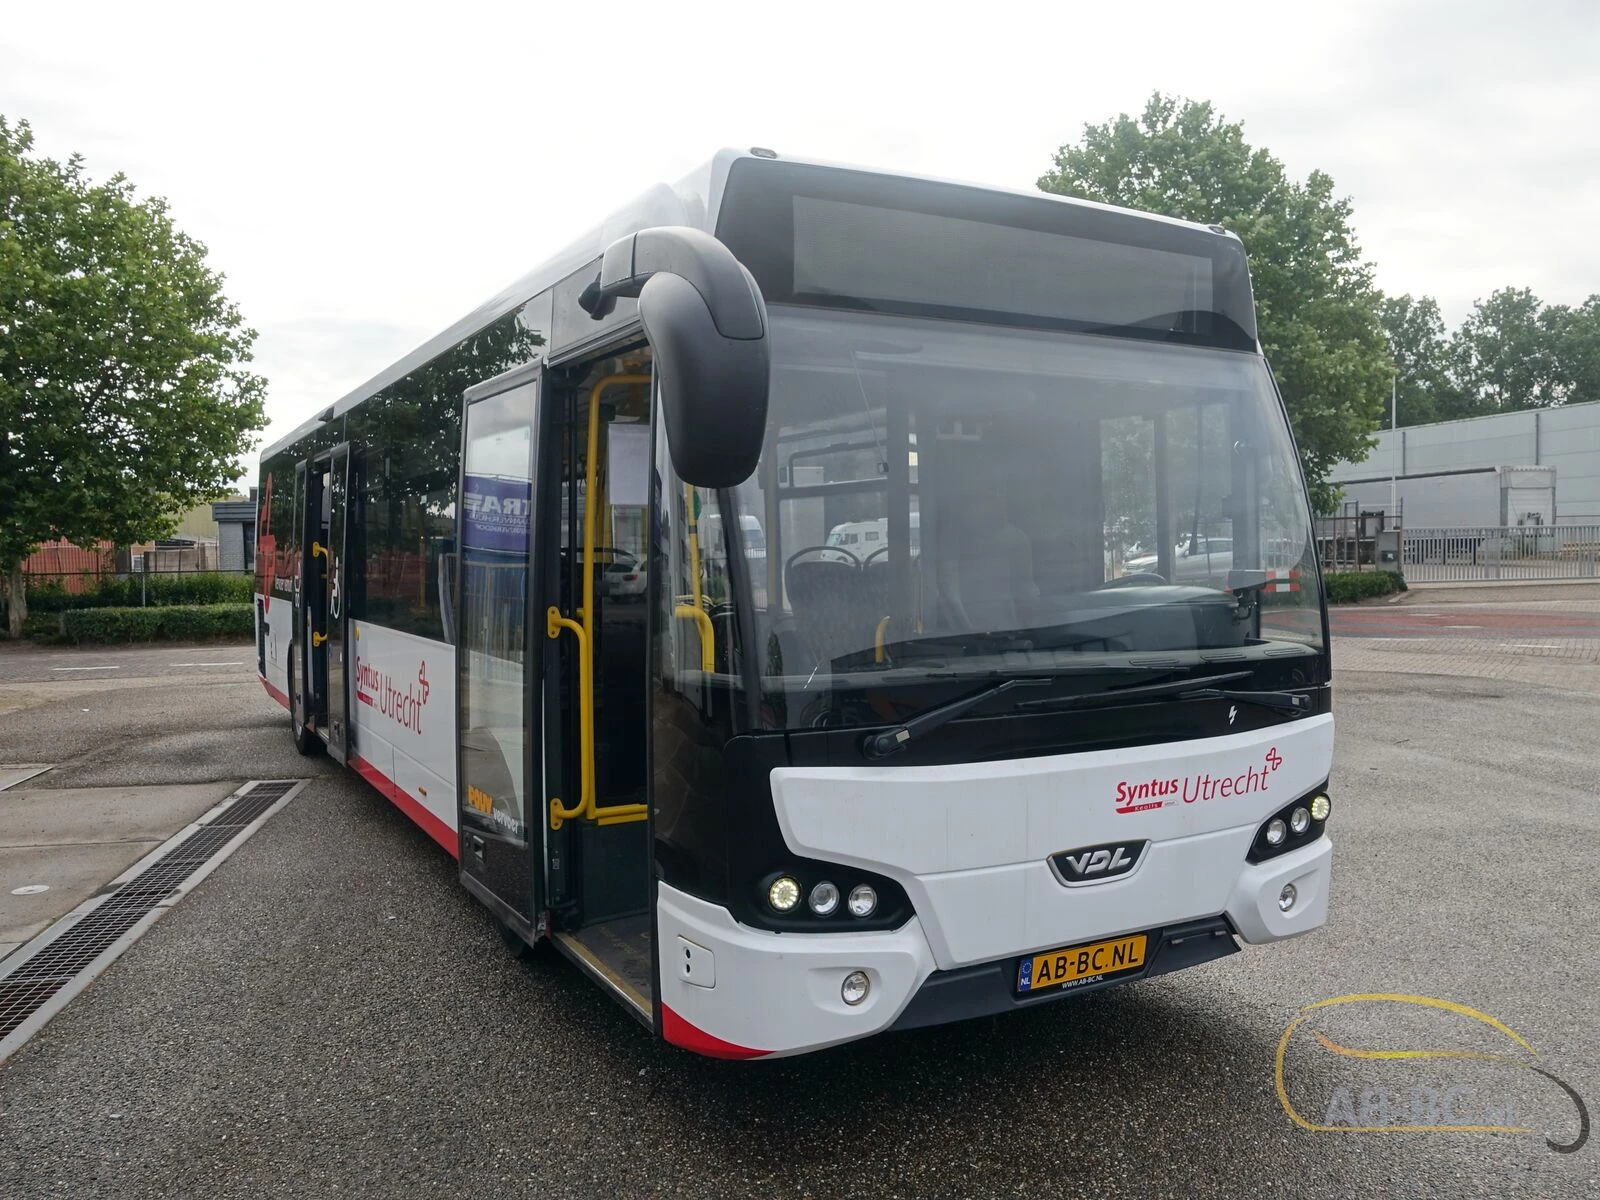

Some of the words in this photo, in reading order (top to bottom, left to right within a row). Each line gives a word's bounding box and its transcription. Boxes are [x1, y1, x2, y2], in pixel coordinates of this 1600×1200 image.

[356, 656, 379, 692] Syntus
[380, 672, 422, 736] Utrecht
[1115, 778, 1179, 807] Syntus
[1182, 765, 1270, 804] Utrecht
[1065, 847, 1132, 875] VDL
[1036, 942, 1138, 984] AB-BC.NL
[1020, 976, 1031, 986] NL
[1061, 974, 1104, 989] WWW.AB-BC.NL
